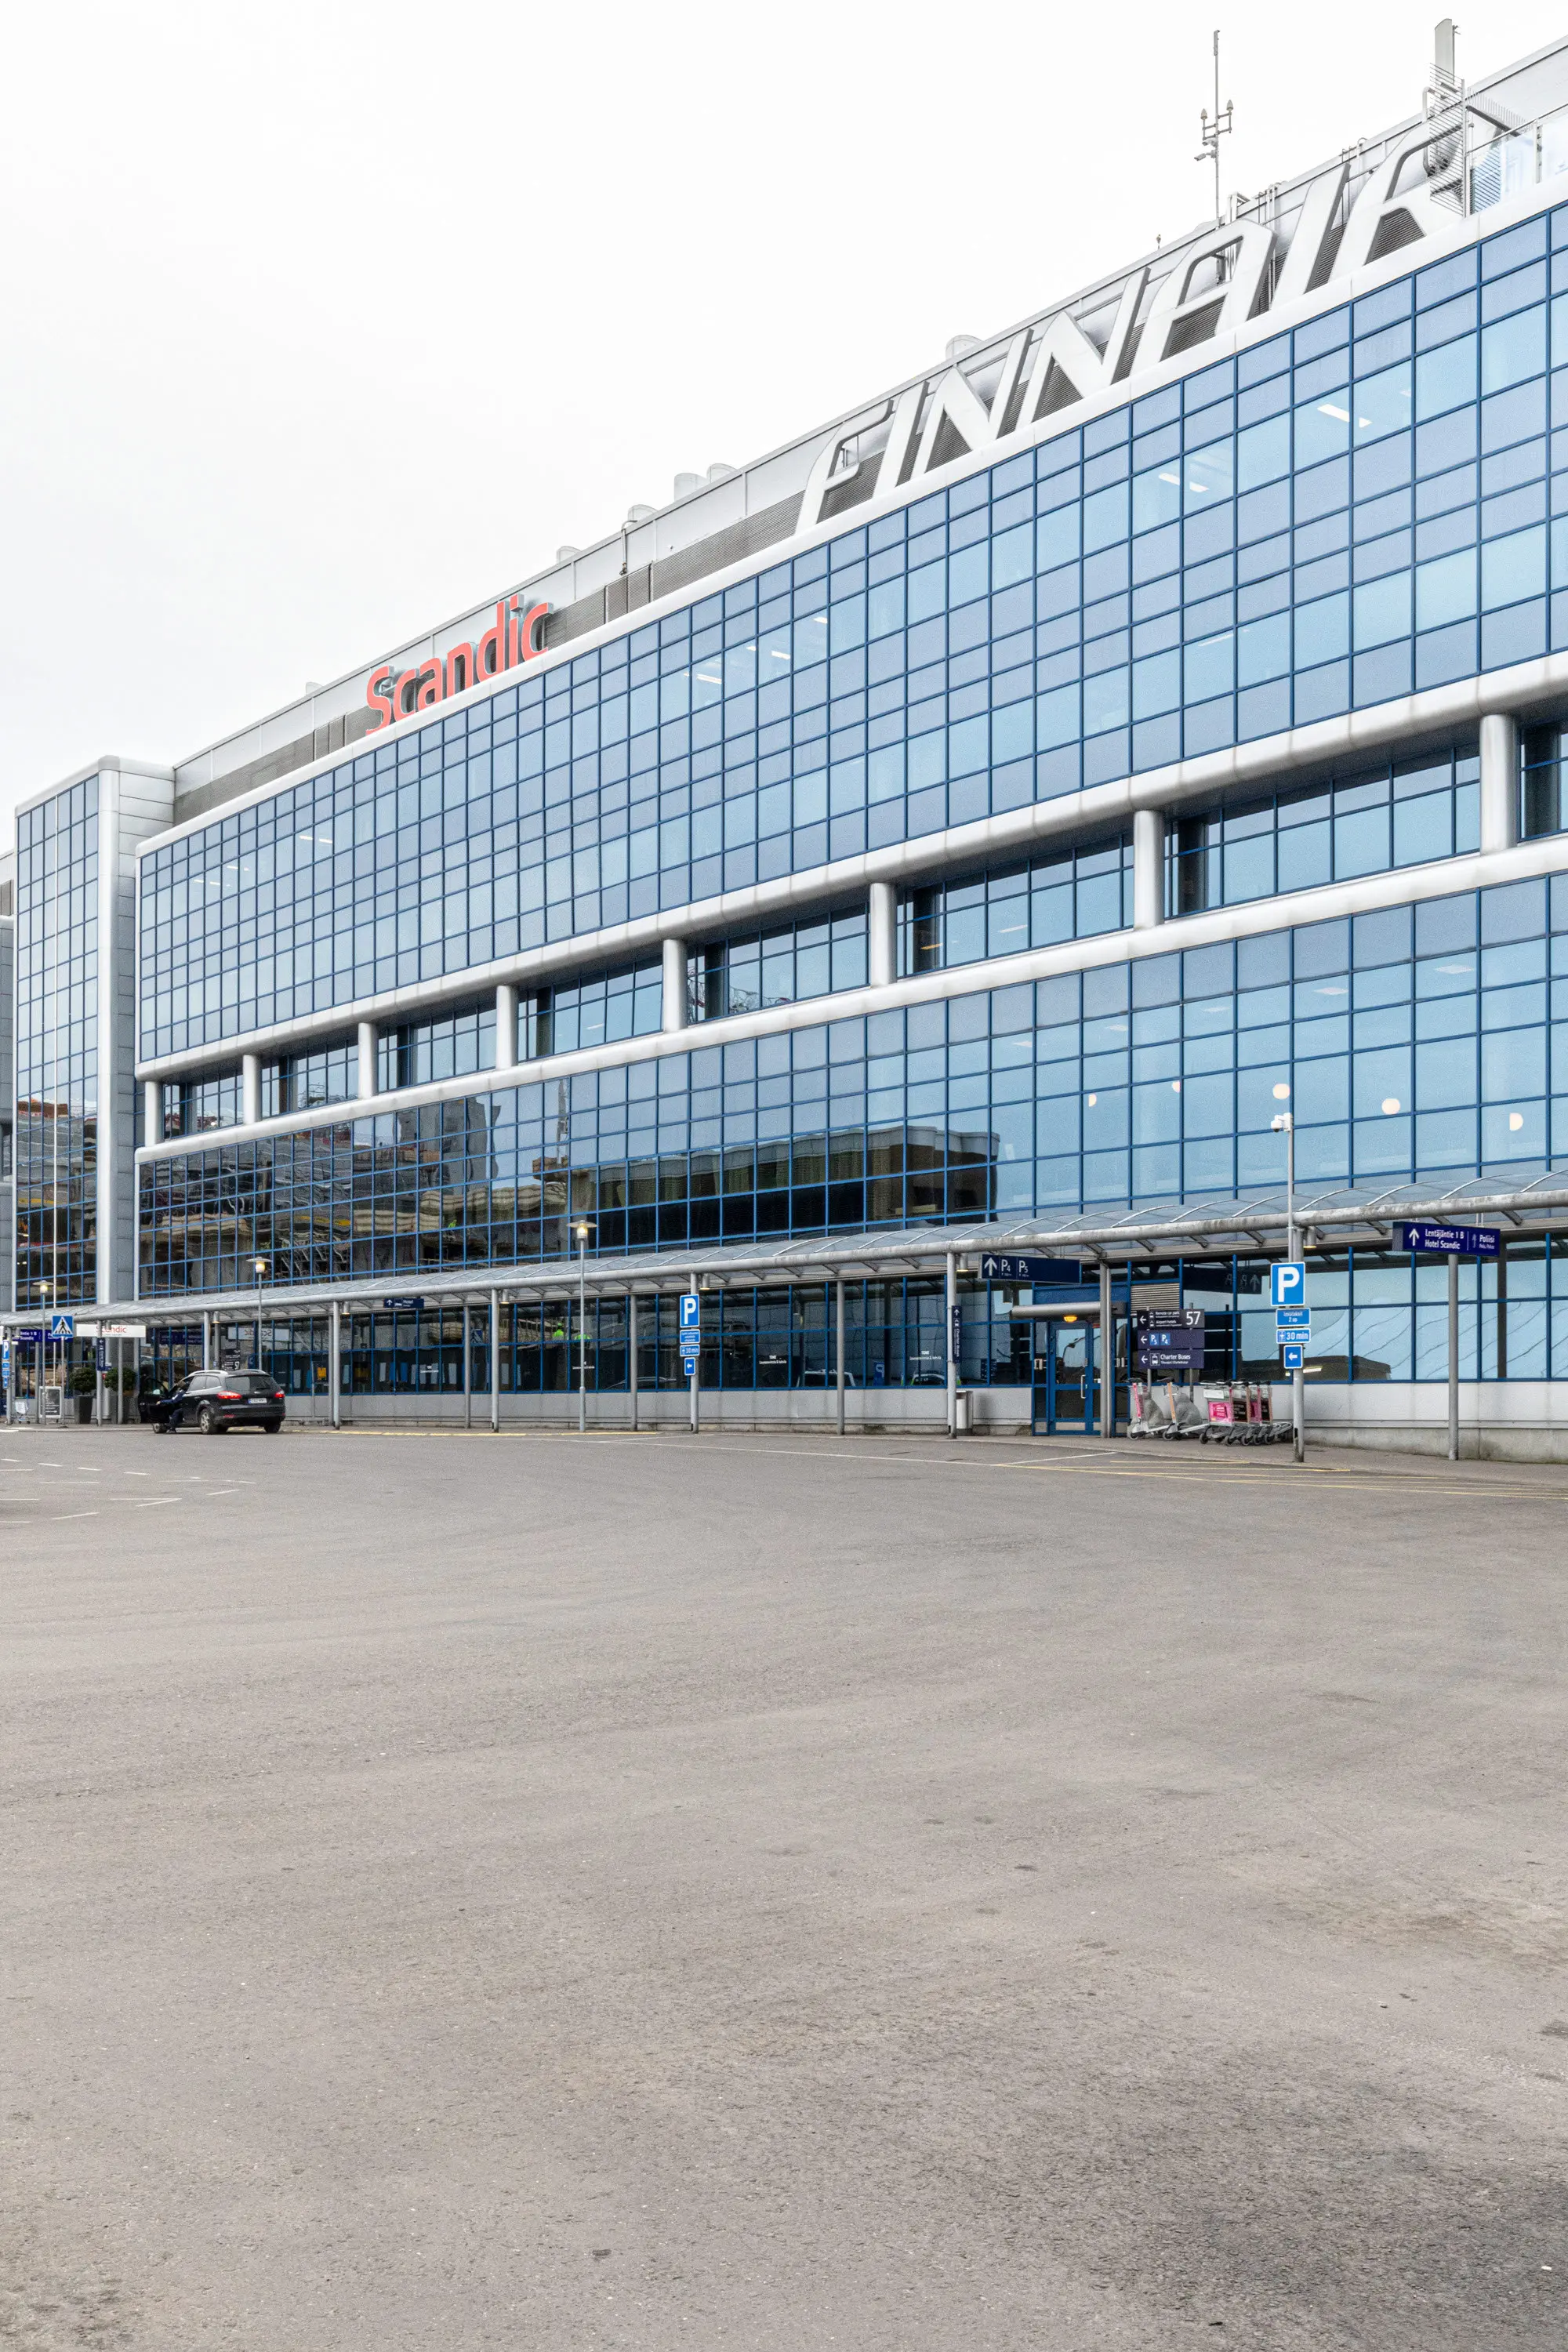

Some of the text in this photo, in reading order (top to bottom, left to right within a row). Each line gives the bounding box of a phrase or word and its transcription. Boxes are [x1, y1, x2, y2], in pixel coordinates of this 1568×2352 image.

[793, 108, 1475, 539] FINNAIR
[366, 593, 553, 735] Scandic
[1425, 1229, 1454, 1239] Lentäjäntie
[1479, 1234, 1495, 1243] Poliisi
[1425, 1240, 1461, 1249] Hotel Scandic
[1278, 1266, 1300, 1302] P
[684, 1298, 696, 1324] P
[1185, 1311, 1201, 1325] 57
[1296, 1331, 1308, 1340] min
[3, 1341, 9, 1358] P
